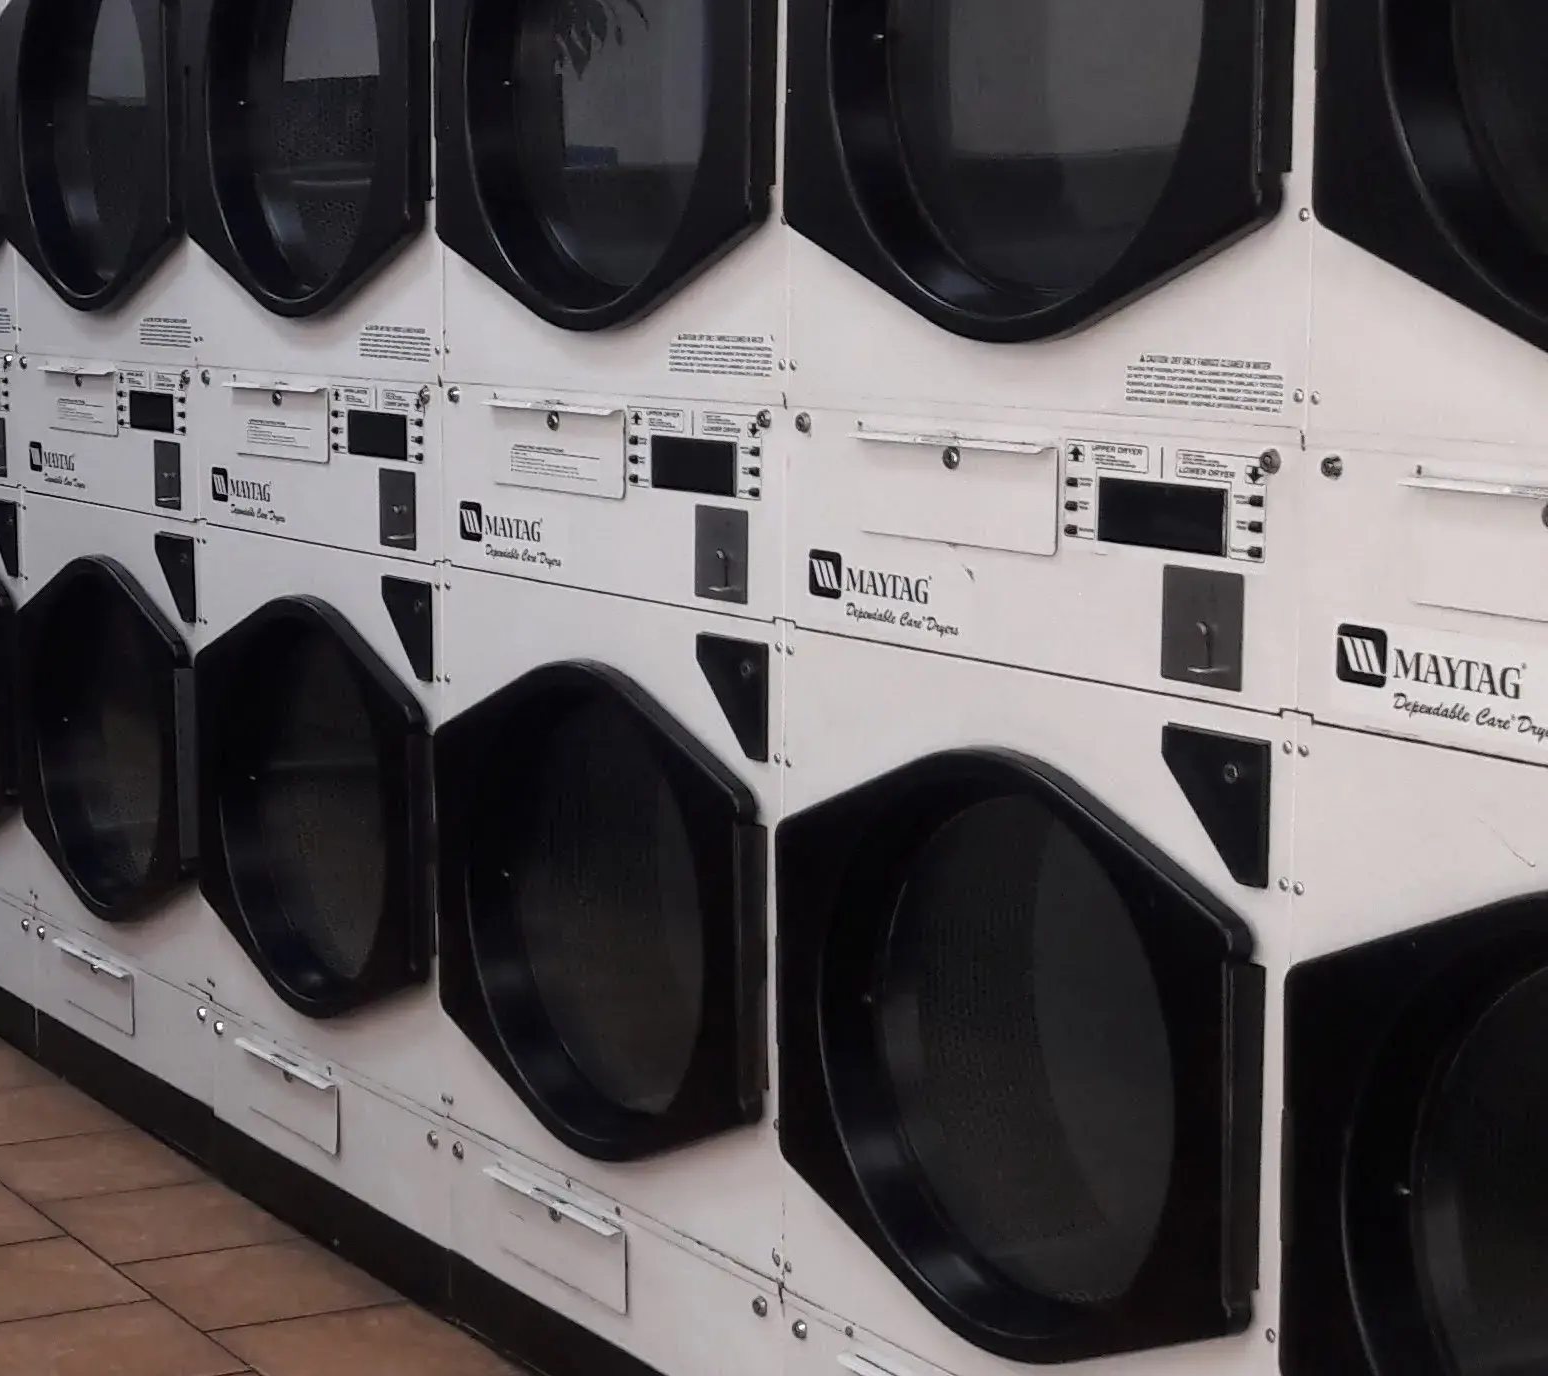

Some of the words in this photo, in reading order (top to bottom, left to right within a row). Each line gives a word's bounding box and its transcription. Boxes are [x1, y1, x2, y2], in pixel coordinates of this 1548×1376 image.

[230, 478, 271, 502] MAYTAG
[485, 514, 541, 542] MAYTAG
[845, 566, 929, 605] MAYTAG
[845, 602, 896, 625] Dependable
[1392, 647, 1522, 700] MAYTAG
[1392, 692, 1470, 723] Dependable
[1475, 707, 1512, 731] Care
